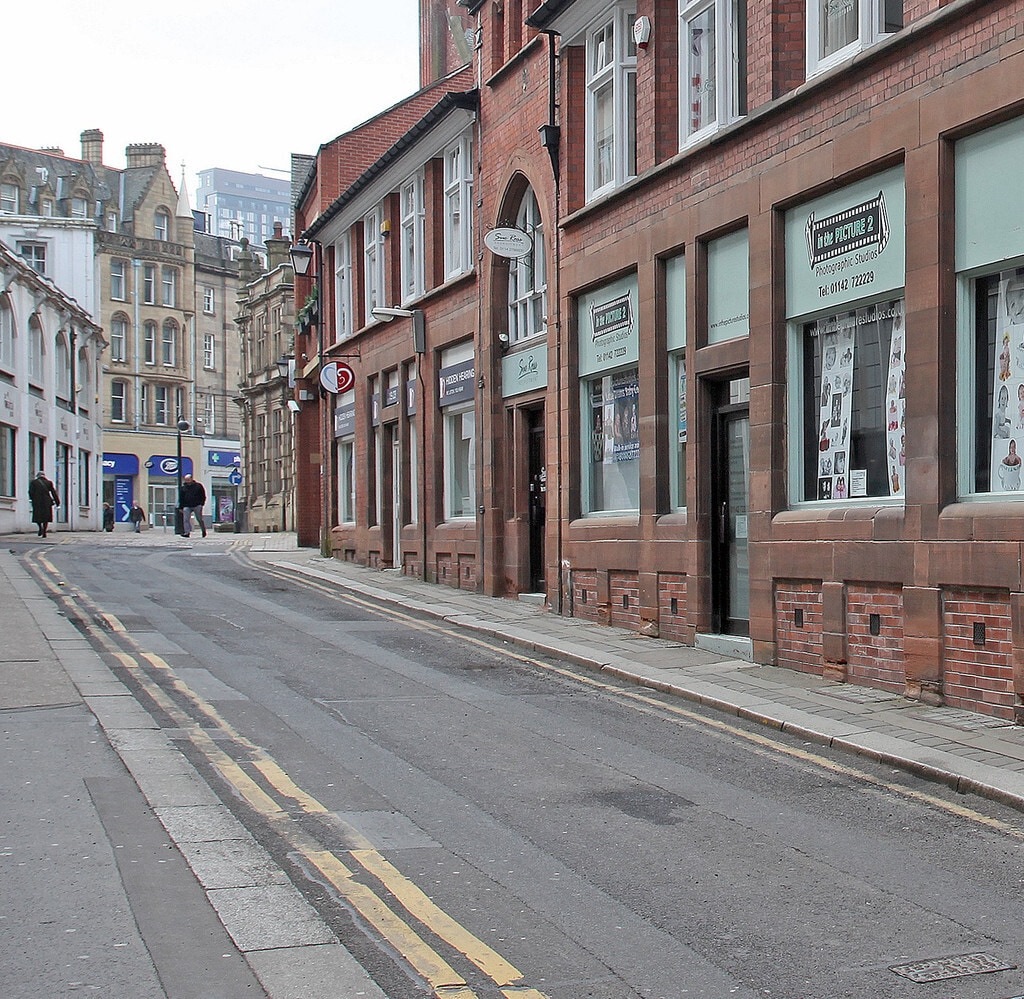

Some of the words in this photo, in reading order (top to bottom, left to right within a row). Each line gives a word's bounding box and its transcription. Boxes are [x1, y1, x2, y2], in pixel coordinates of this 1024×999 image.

[817, 233, 824, 249] in
[823, 230, 834, 247] the
[835, 218, 866, 243] PICTURE
[867, 215, 874, 232] 2
[815, 254, 853, 277] Photographic
[855, 248, 878, 266] Studios
[818, 284, 829, 298] Tel:
[830, 278, 849, 295] 01142
[851, 270, 875, 289] 722229
[445, 372, 459, 386] HIDDEN
[459, 368, 475, 381] HEARING
